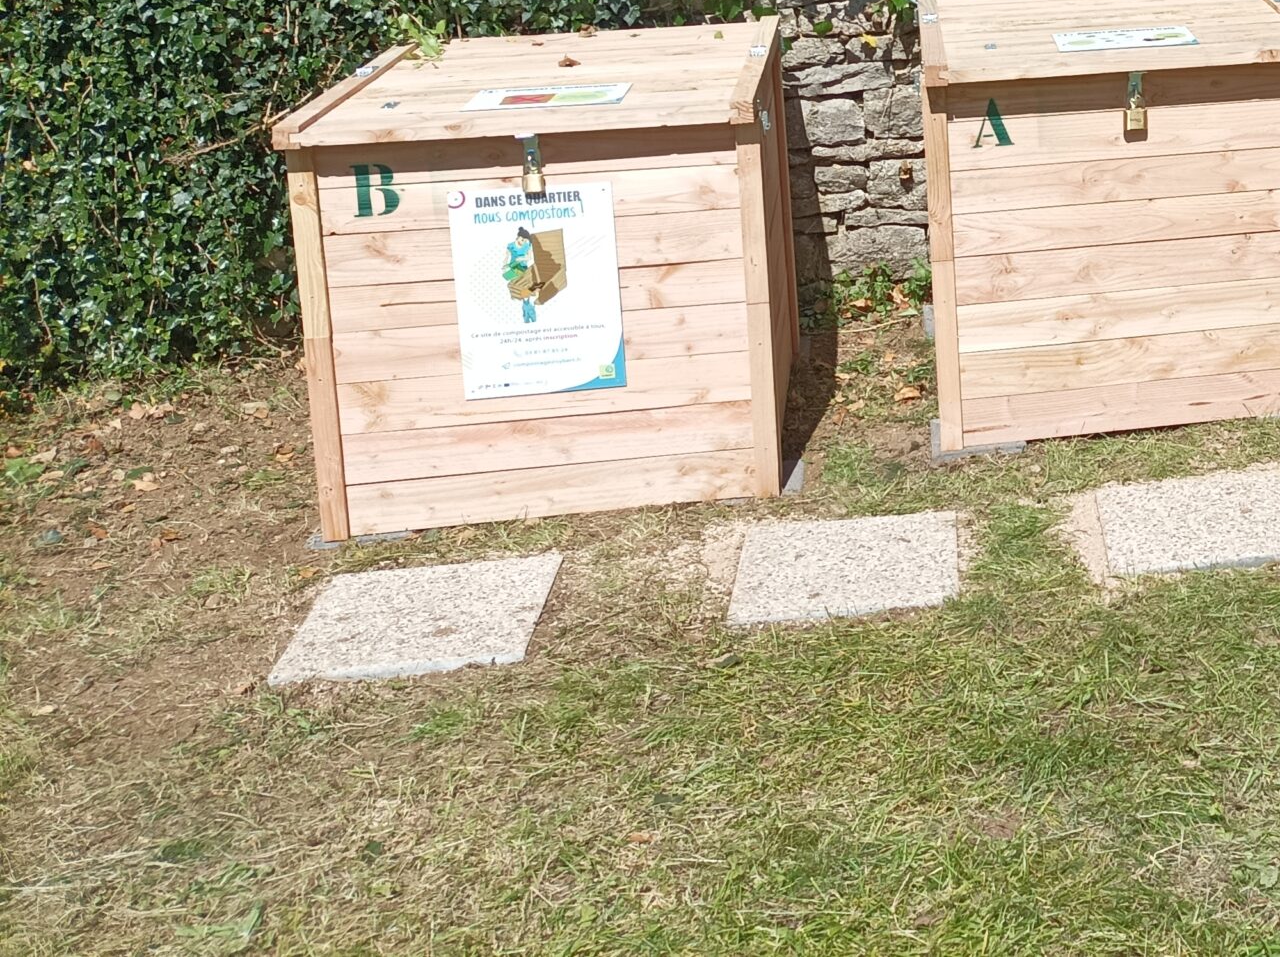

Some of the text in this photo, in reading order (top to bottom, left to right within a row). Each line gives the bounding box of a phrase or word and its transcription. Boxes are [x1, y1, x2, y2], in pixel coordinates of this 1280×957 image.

[972, 97, 1015, 148] A
[349, 163, 401, 218] B
[475, 190, 581, 208] DANS CE QUARTIER
[474, 211, 502, 224] nous
[505, 205, 577, 228] compostons
